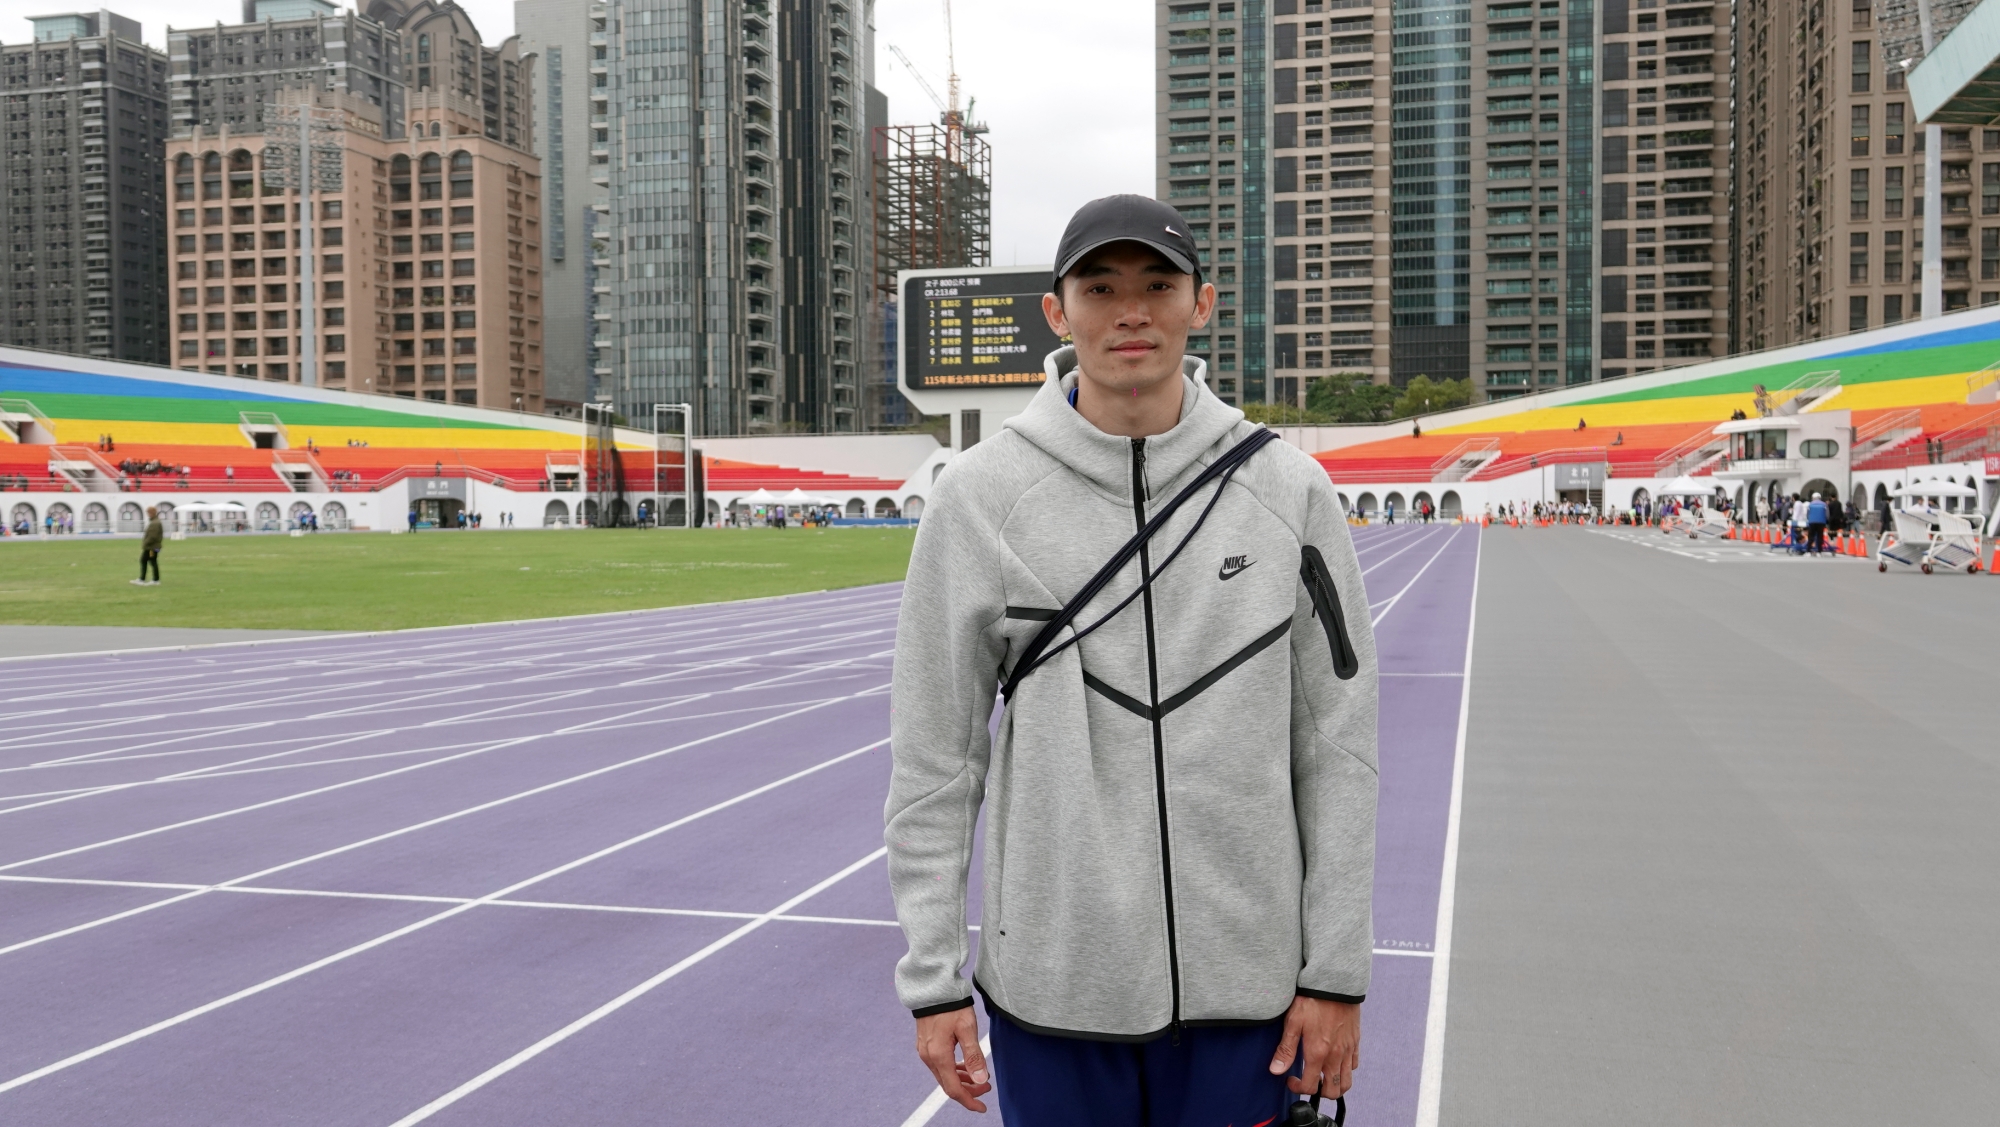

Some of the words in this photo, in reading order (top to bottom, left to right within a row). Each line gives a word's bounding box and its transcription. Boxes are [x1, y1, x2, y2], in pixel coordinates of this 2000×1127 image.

[925, 279, 938, 287] 女子
[929, 309, 935, 318] 2
[929, 319, 935, 327] 3
[929, 338, 935, 346] 5
[929, 347, 935, 356] 6
[1223, 555, 1247, 570] NIKE
